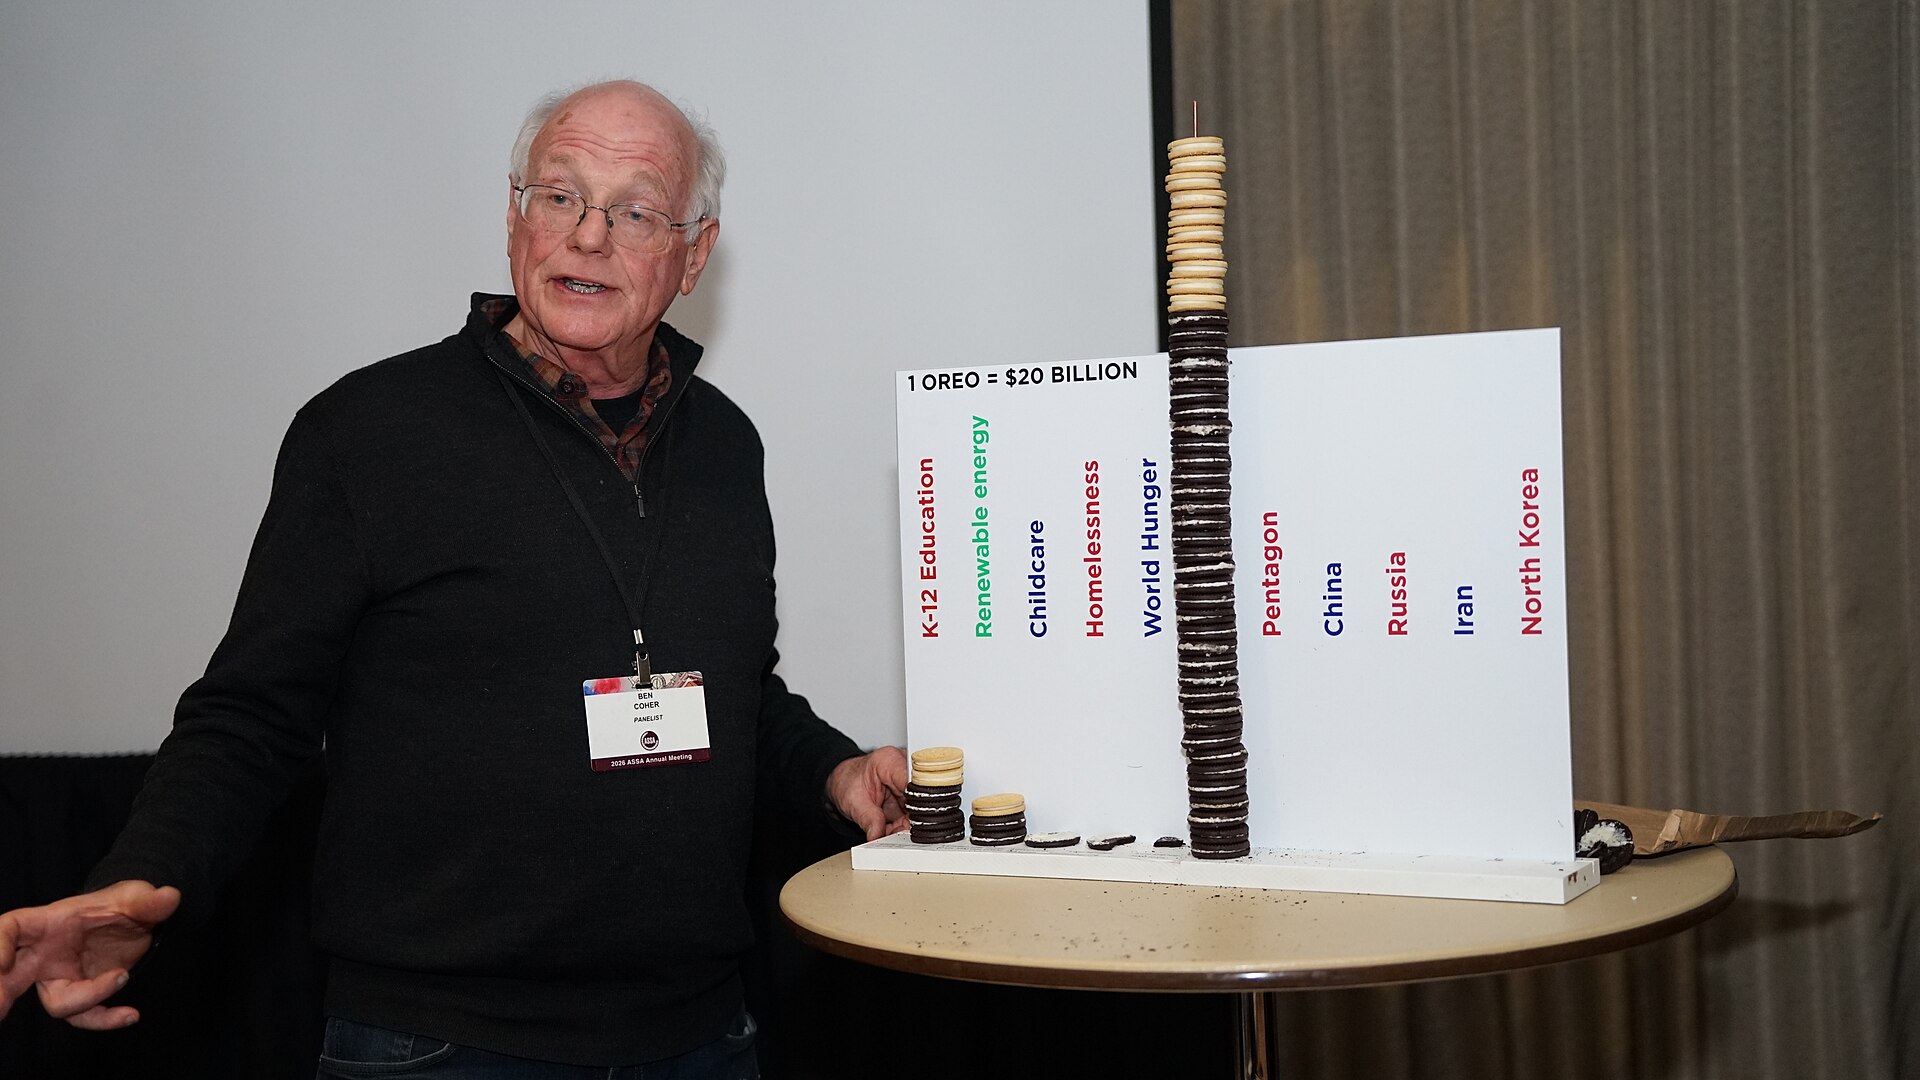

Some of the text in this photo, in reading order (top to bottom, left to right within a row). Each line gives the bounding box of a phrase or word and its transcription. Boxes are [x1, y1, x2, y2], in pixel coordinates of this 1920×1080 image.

[907, 375, 916, 391] 1
[922, 371, 980, 390] OREO
[1005, 367, 1044, 387] $20
[1051, 361, 1138, 383] BILLION
[917, 457, 939, 638] K-12 Education
[971, 415, 992, 637] Renewable energy
[1084, 460, 1104, 637] Homelessness
[1141, 457, 1162, 637] World Hunger
[1518, 468, 1542, 635] North Korea
[1028, 519, 1047, 638] Childcare
[1261, 511, 1283, 636] Pentagon
[1322, 562, 1344, 637] China
[1385, 551, 1408, 636] Russia
[1453, 585, 1474, 635] Iran
[634, 701, 660, 710] COHER
[634, 714, 663, 723] PANELIST
[638, 692, 653, 700] BEN
[626, 758, 645, 766] ASSA
[645, 755, 668, 764] Annual
[668, 753, 693, 762] Meeting
